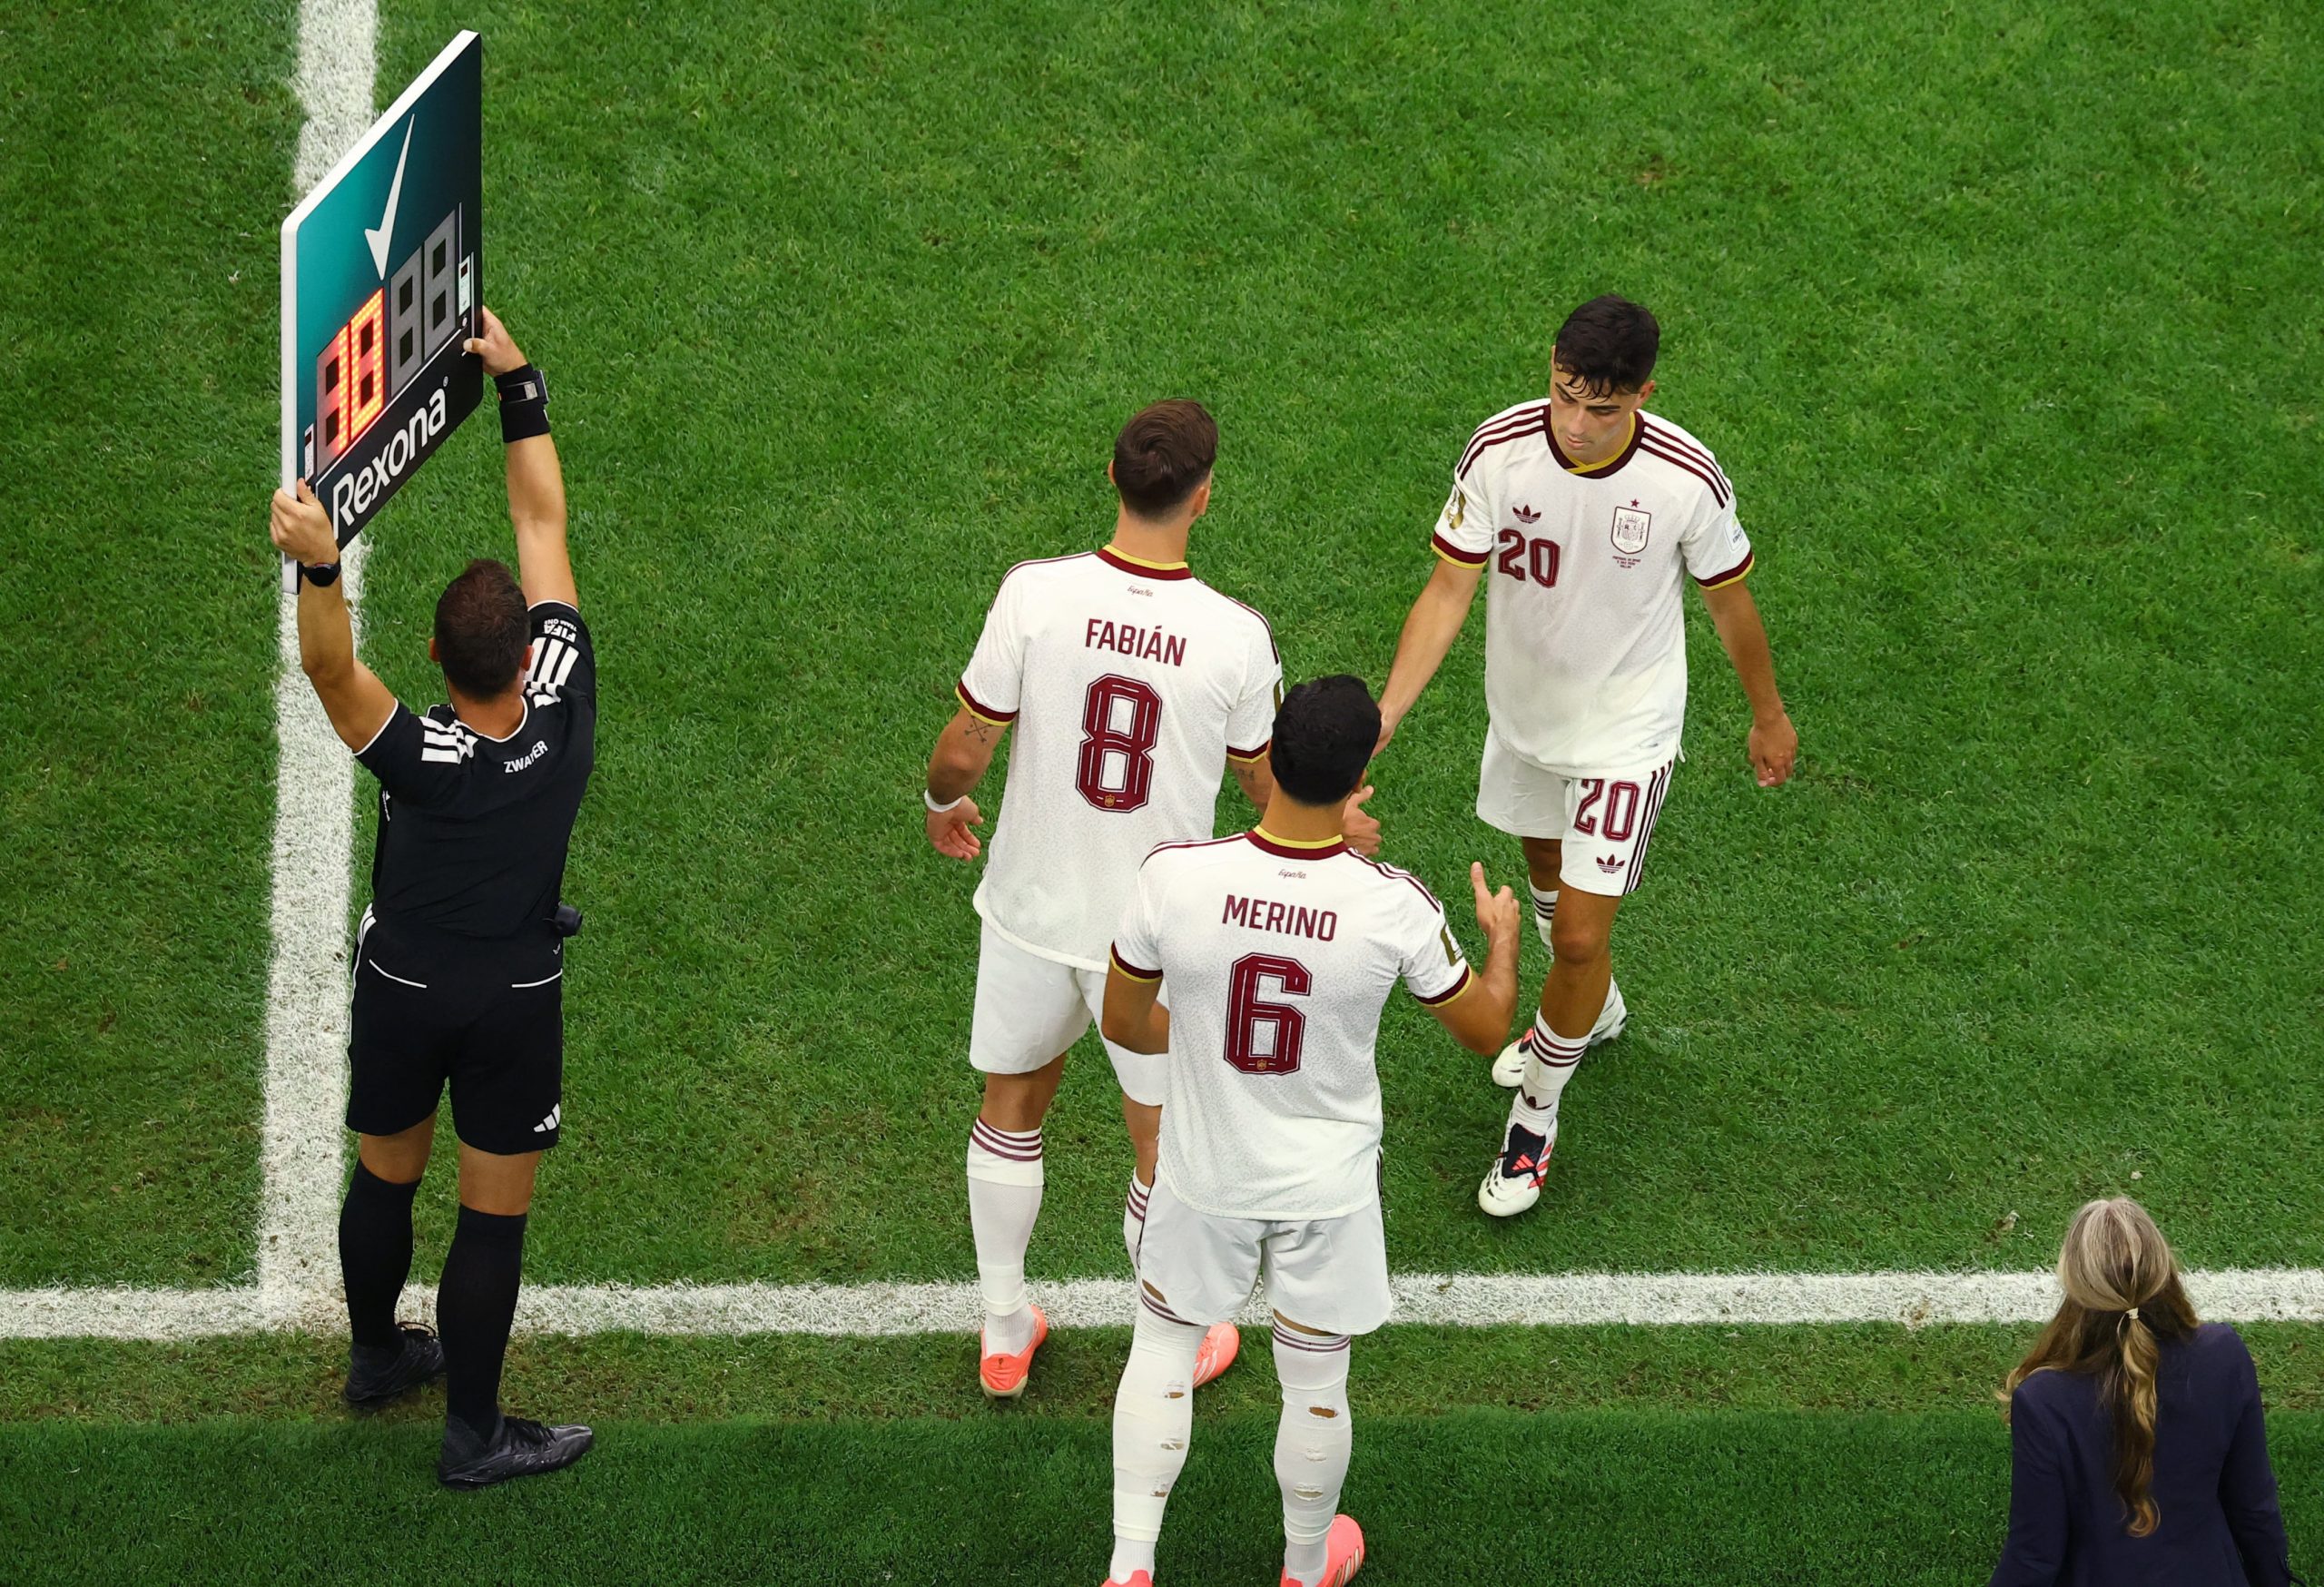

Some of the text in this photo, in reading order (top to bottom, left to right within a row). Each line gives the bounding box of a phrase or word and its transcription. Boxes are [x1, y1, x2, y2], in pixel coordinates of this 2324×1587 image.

[332, 388, 447, 541] Rexona
[1498, 527, 1561, 589] 20
[543, 624, 576, 644] FIFA
[1085, 618, 1187, 667] FABIÁN
[1075, 673, 1163, 813] 8
[1572, 778, 1641, 843] 20
[1221, 894, 1338, 942] MERINO
[1223, 951, 1313, 1076] 6
